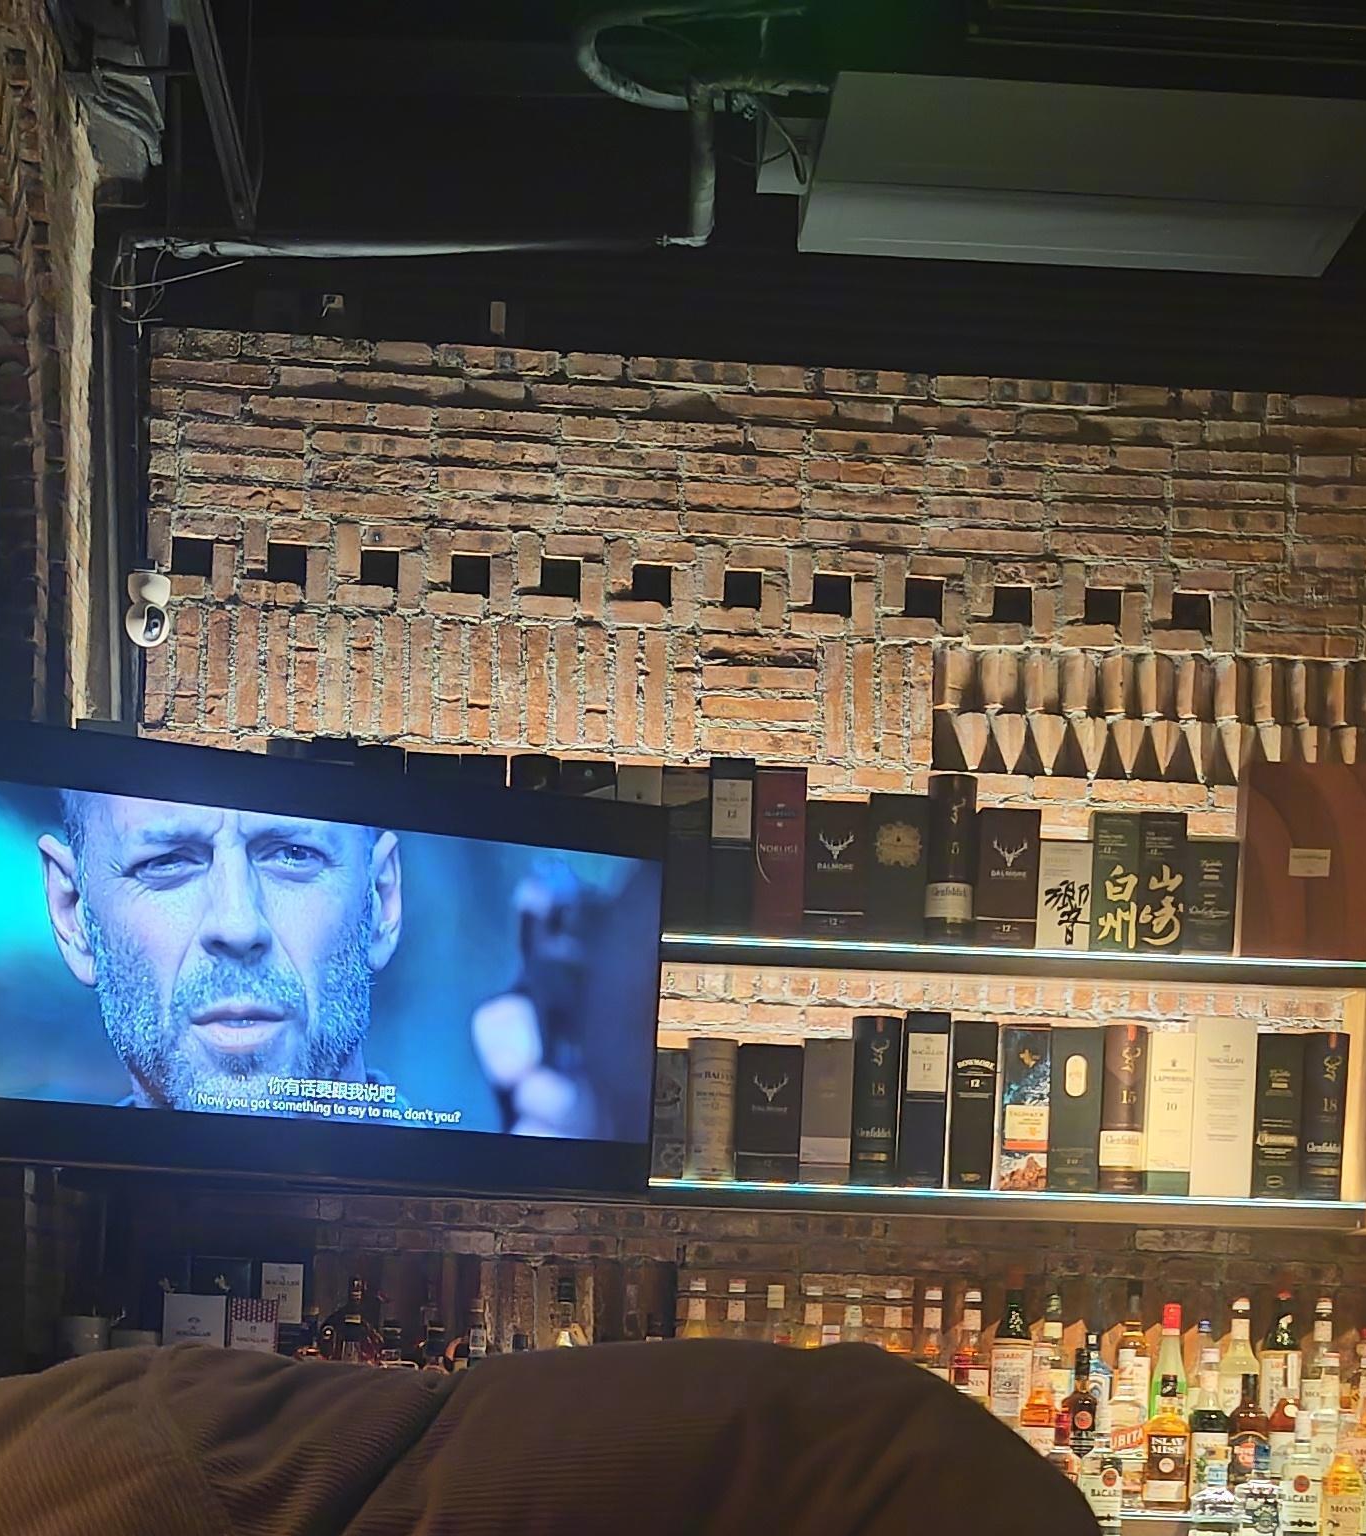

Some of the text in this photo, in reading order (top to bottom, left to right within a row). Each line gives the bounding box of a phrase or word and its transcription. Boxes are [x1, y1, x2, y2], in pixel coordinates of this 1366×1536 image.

[1097, 864, 1139, 949] 白州
[267, 1077, 396, 1103] 你有话要跟我说吧
[871, 1082, 885, 1097] 18
[197, 1092, 462, 1125] Now you got something to say to me, don't you?
[1151, 1436, 1185, 1445] ISLAY
[1151, 1445, 1184, 1454] MIST
